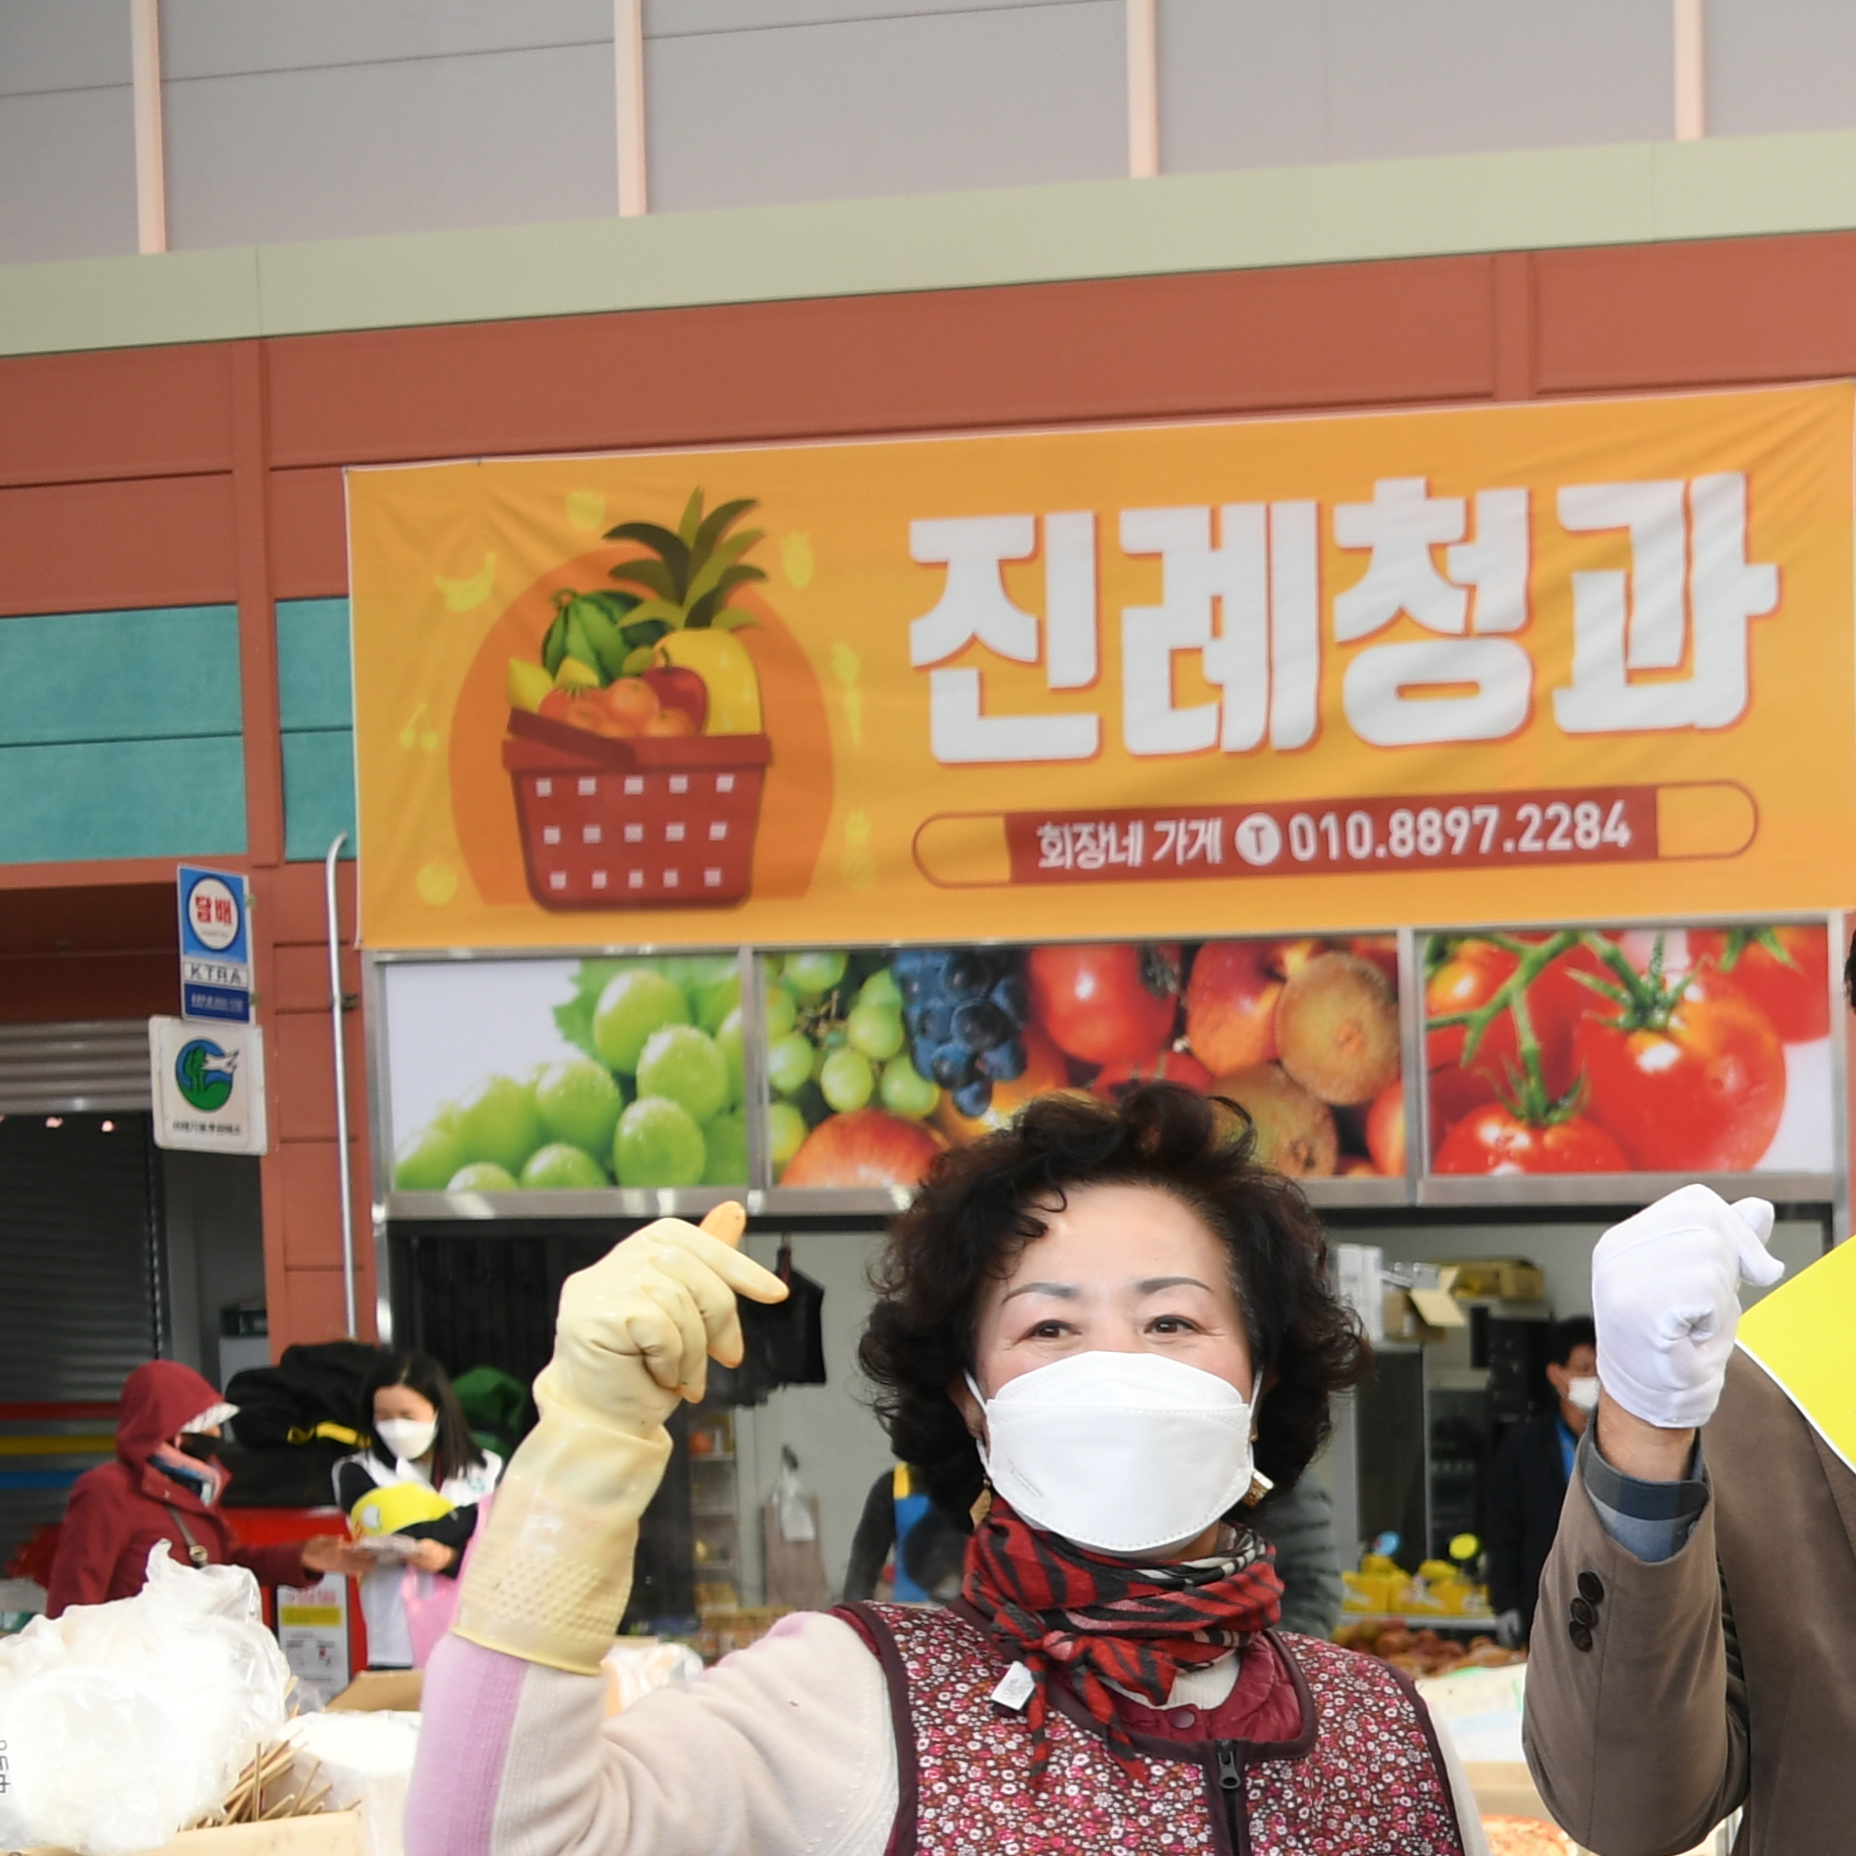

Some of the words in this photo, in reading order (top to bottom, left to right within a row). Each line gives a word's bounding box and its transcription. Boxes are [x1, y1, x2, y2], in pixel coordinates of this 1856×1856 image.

[908, 472, 1780, 764] 진례청과
[1036, 820, 1145, 870] 회장네
[1152, 816, 1223, 865] 가게
[1288, 799, 1633, 862] 010.8897.2284
[194, 895, 232, 925] 담배
